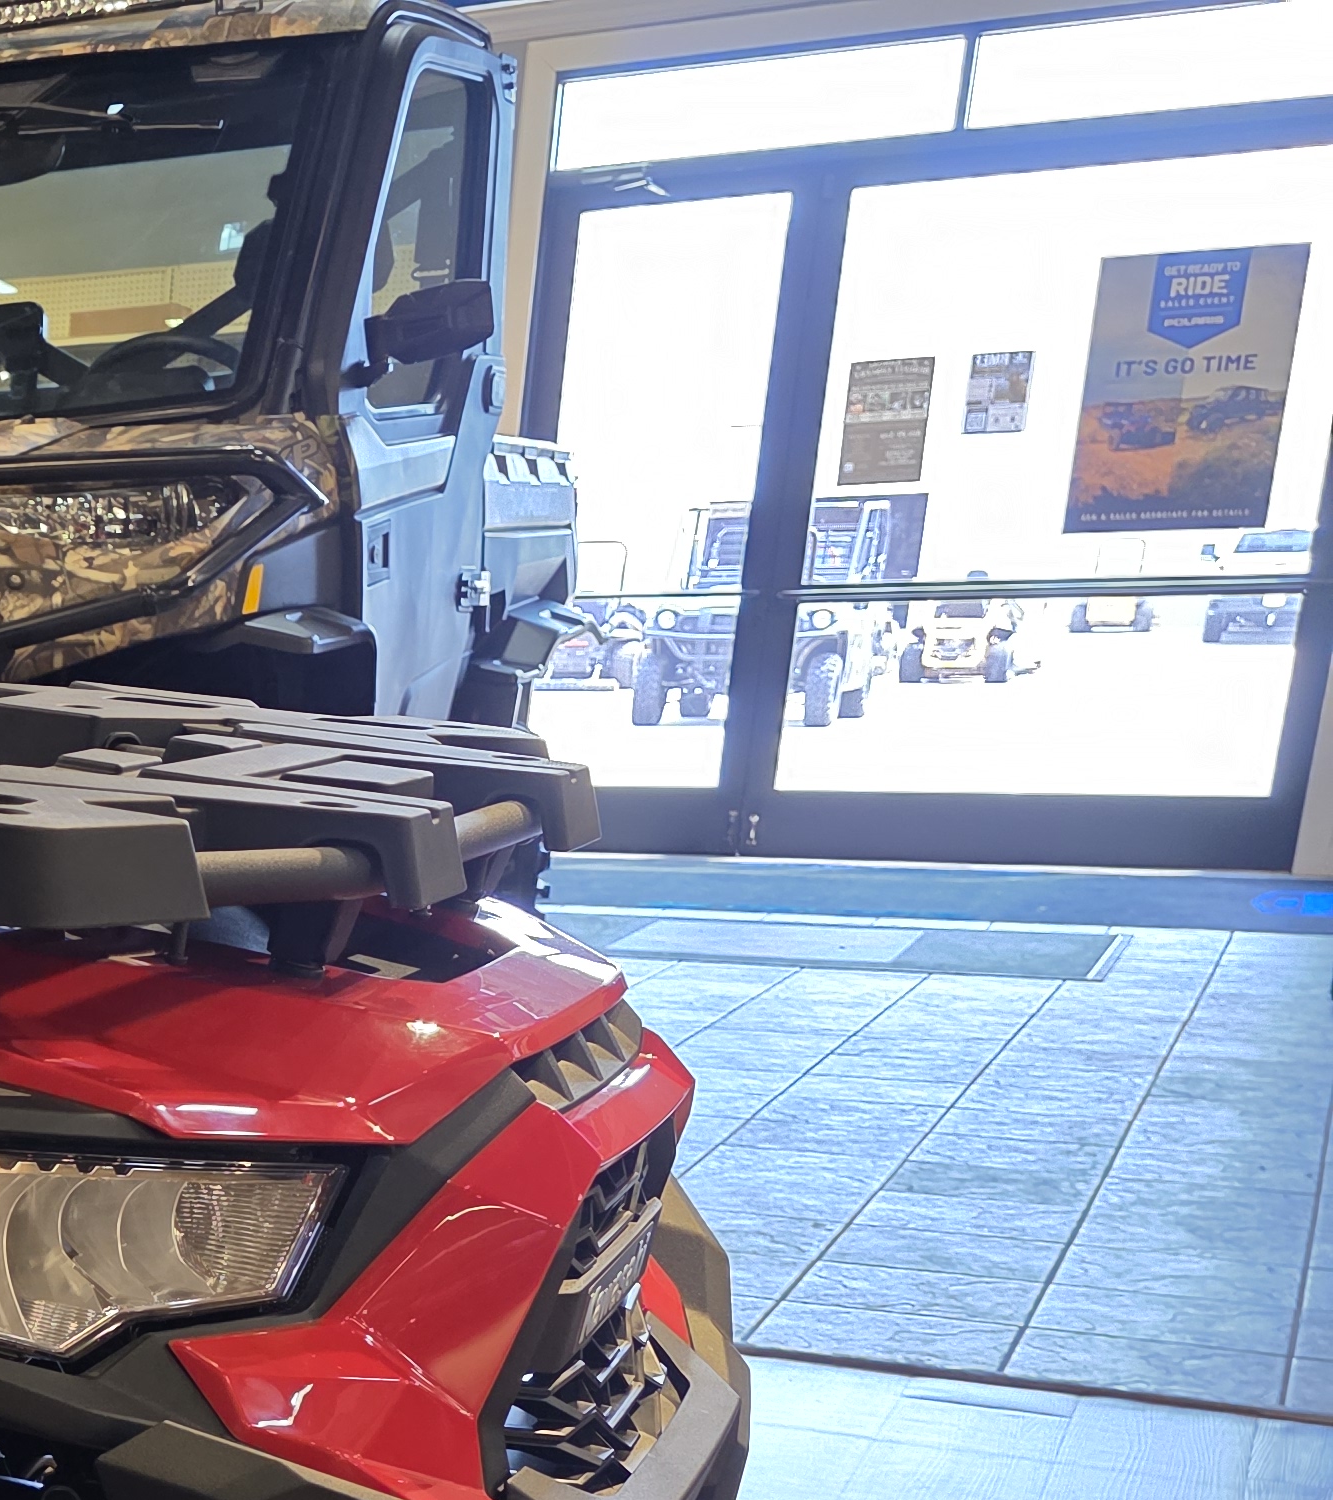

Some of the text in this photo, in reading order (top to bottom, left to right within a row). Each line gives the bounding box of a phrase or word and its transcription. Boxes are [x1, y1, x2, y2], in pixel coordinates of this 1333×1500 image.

[1164, 261, 1242, 276] GET READY TO
[1170, 274, 1230, 298] RIDE
[1164, 315, 1224, 327] POLARIS
[1115, 353, 1259, 378] IT'S GO TIME
[579, 1231, 652, 1345] Kawasaki
